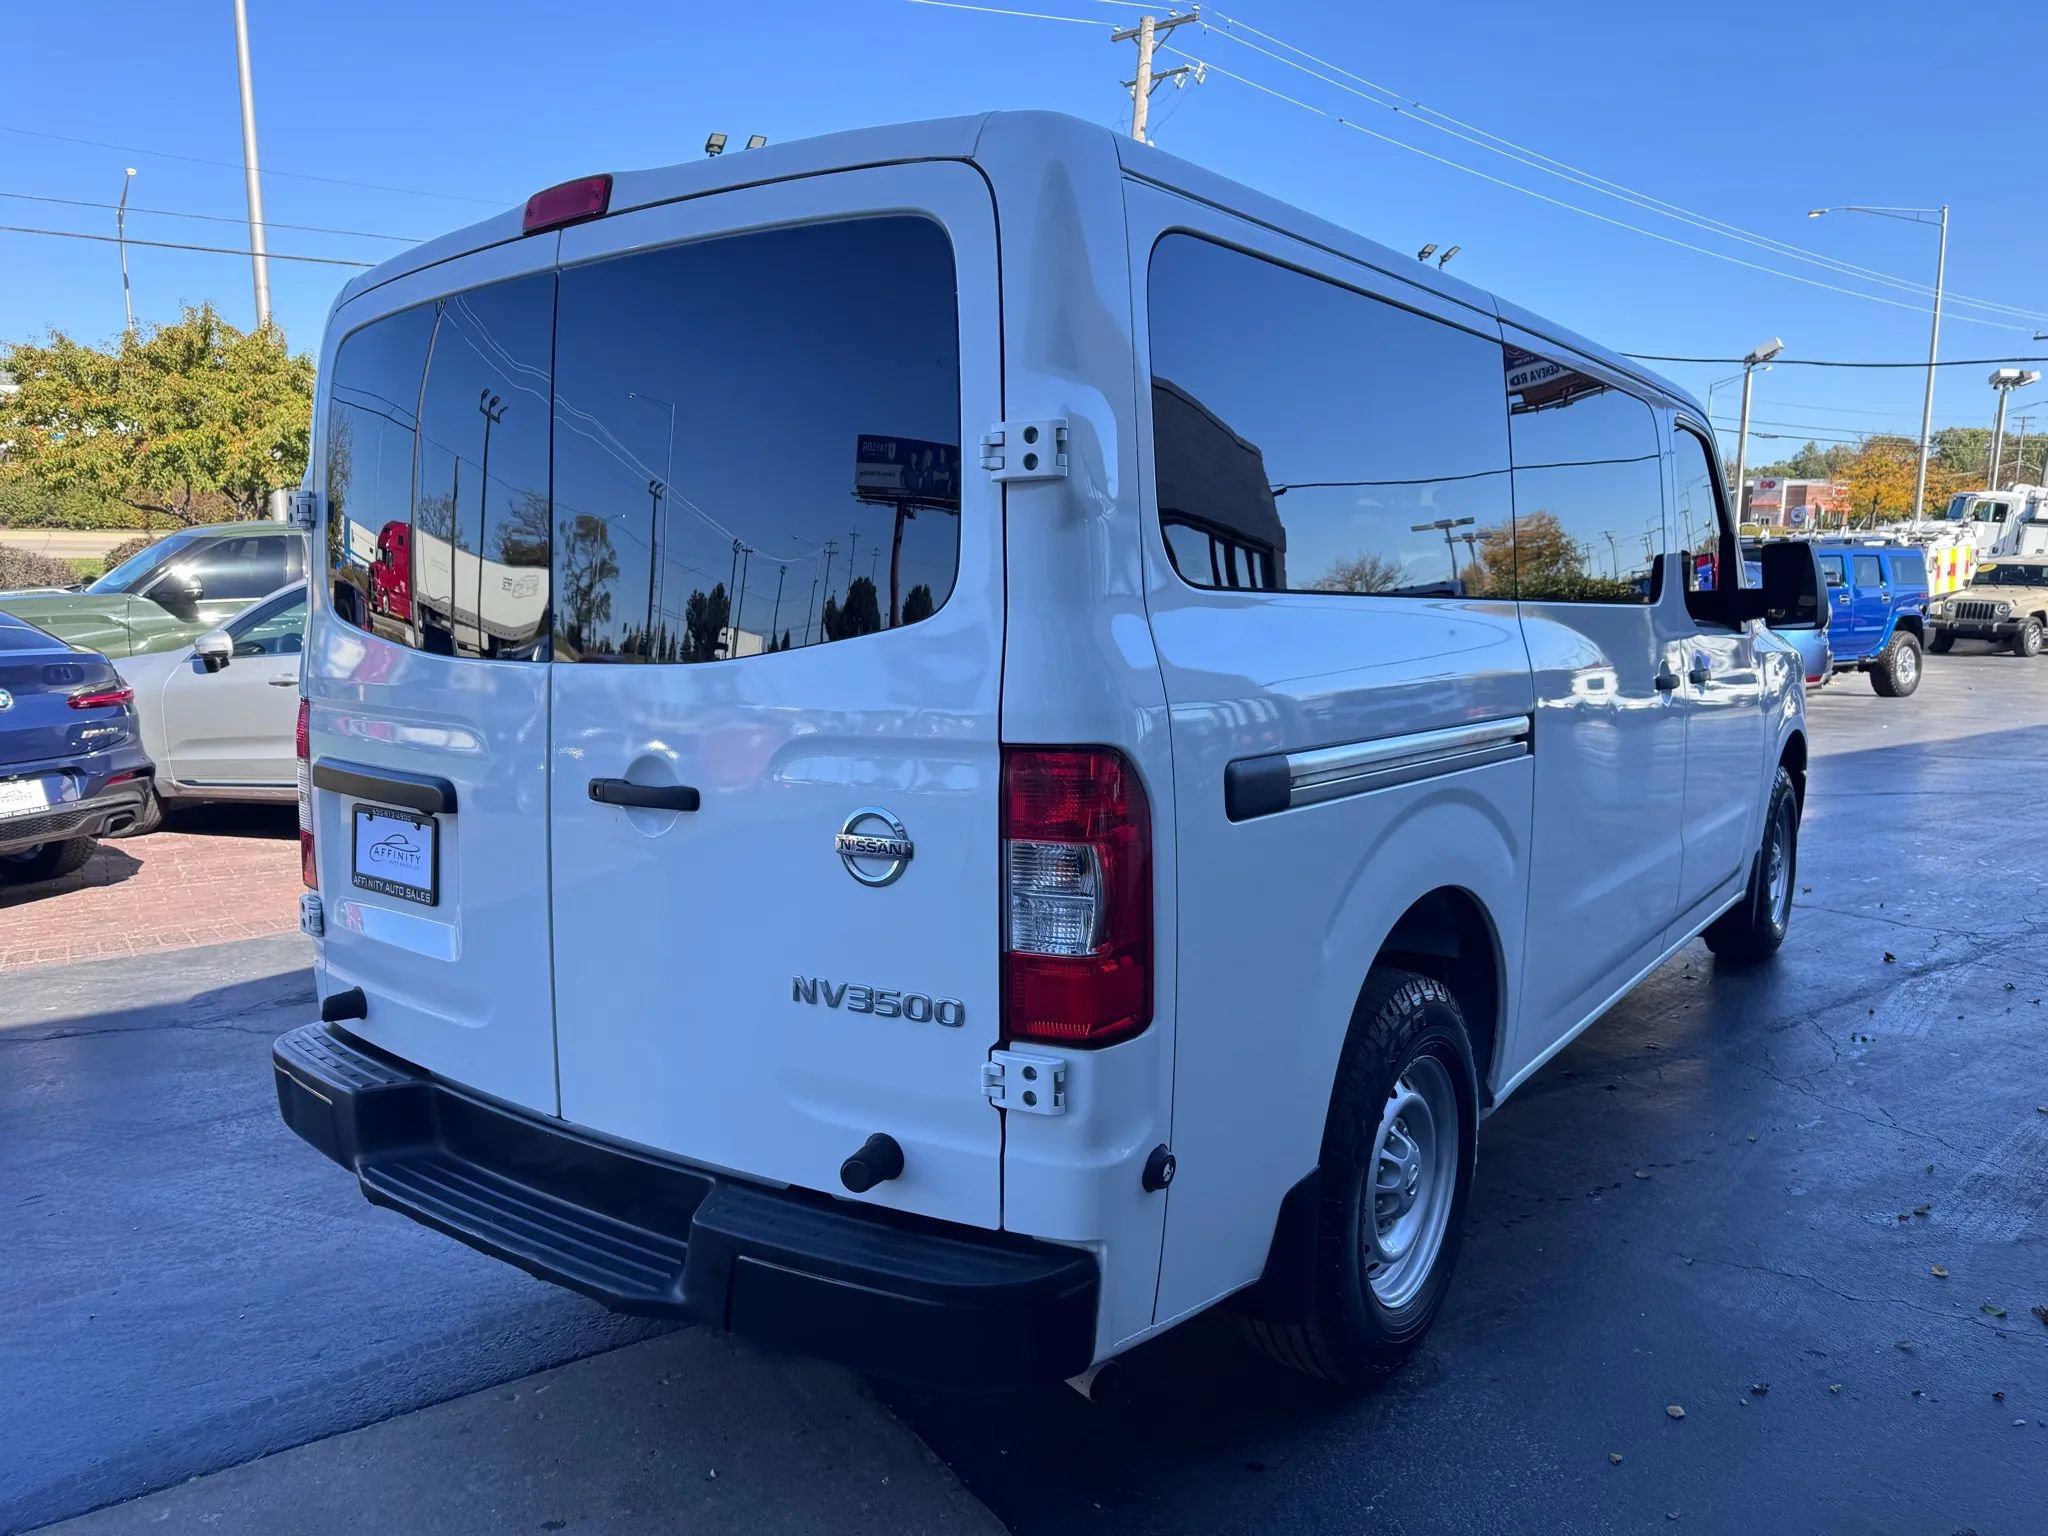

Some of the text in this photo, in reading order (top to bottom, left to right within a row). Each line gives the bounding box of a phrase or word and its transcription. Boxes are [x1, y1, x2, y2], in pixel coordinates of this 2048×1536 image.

[374, 847, 421, 864] AFFINITY
[838, 838, 902, 856] NISSAN
[354, 876, 431, 902] AFFINITY AUTO SALES
[792, 974, 965, 1027] NV3500
